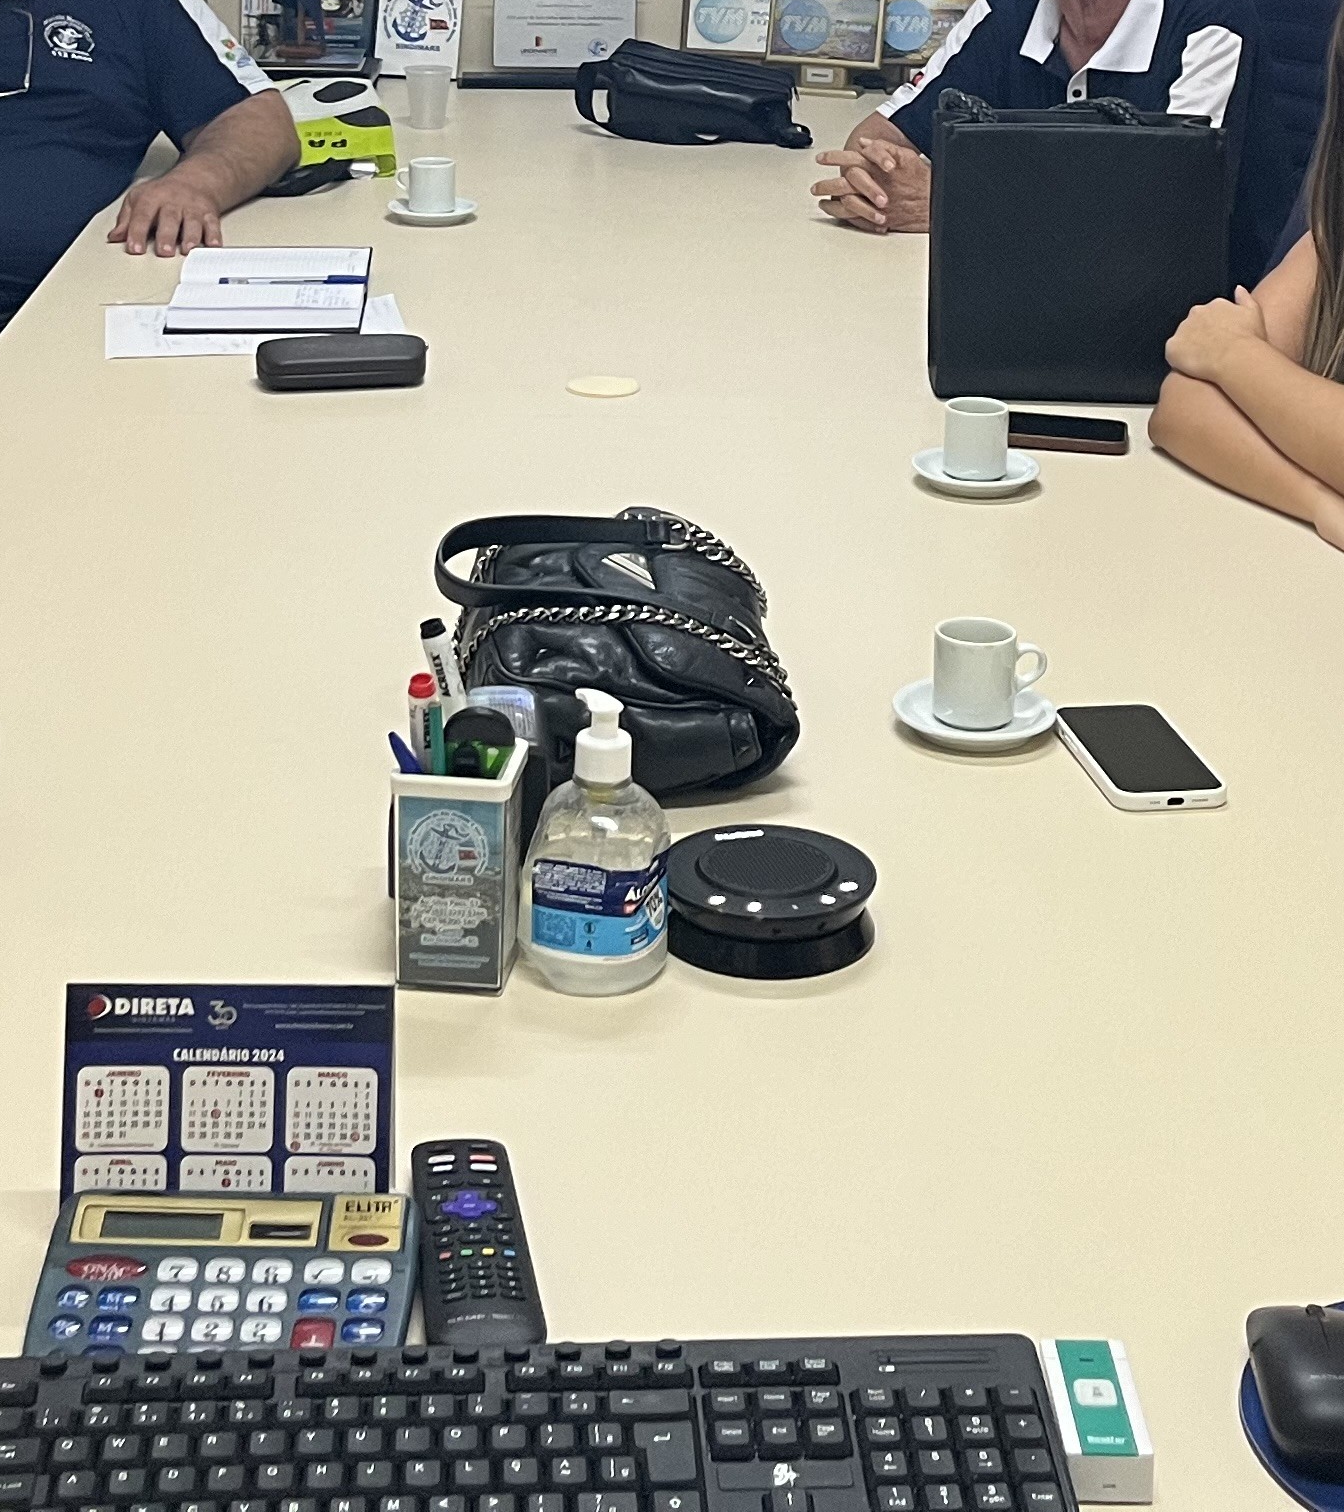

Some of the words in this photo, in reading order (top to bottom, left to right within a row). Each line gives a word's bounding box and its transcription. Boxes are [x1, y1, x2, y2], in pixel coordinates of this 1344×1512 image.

[697, 6, 747, 26] TVM
[780, 14, 829, 34] TVM
[114, 997, 195, 1017] DIRETA
[172, 1046, 250, 1062] CALENDÁRIO
[252, 1048, 285, 1063] 2024
